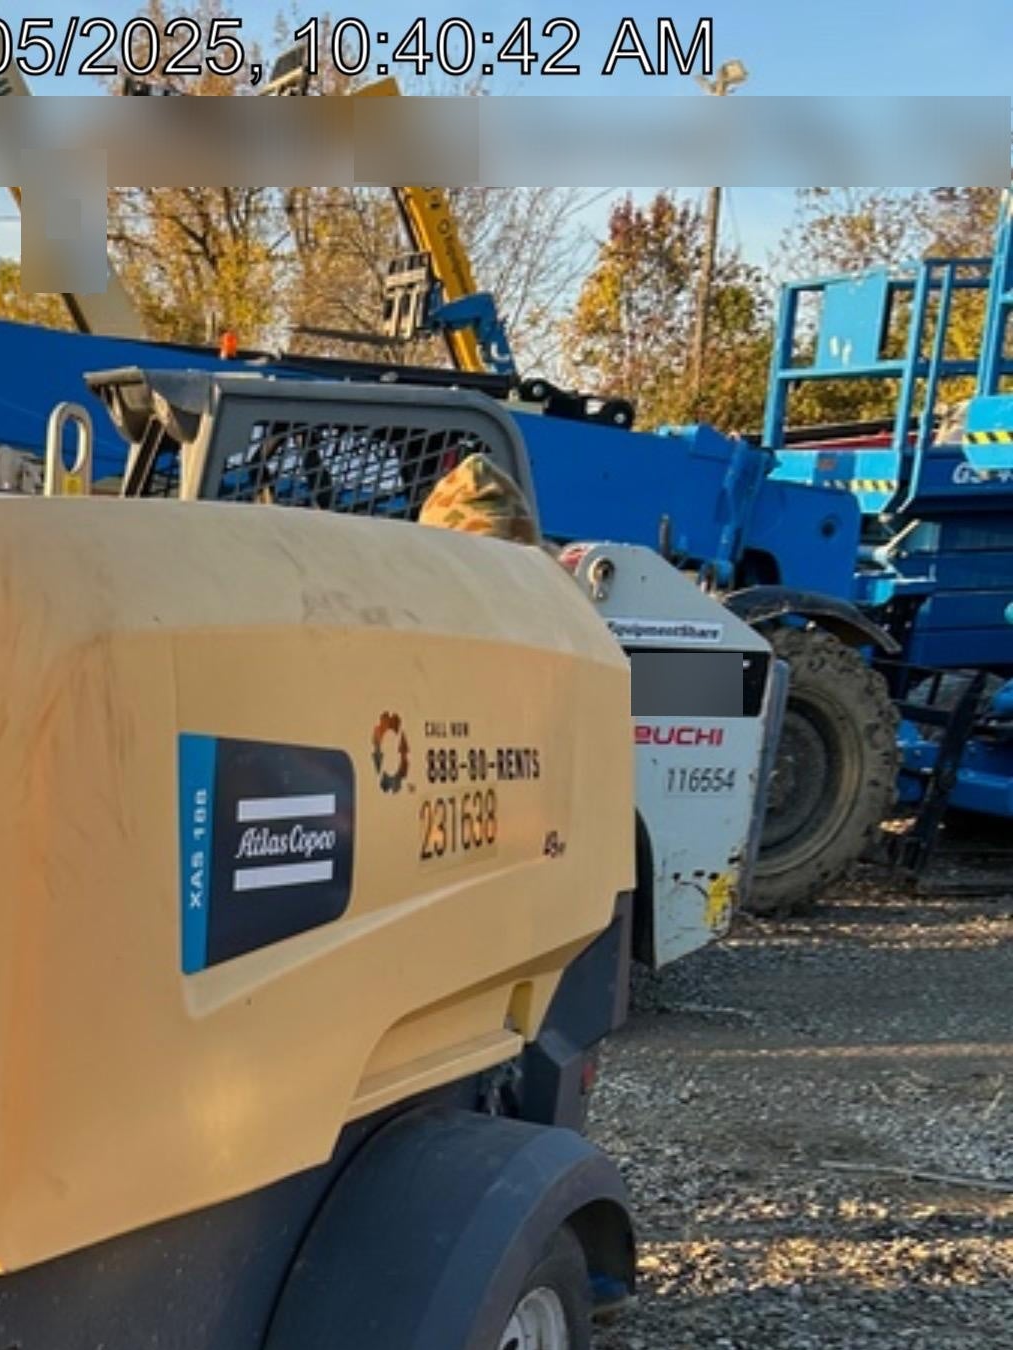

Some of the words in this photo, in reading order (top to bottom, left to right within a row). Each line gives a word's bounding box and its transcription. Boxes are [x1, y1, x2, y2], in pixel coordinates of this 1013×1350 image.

[667, 767, 736, 793] 116554
[234, 827, 288, 858] Atlas
[289, 824, 336, 857] Copco
[419, 788, 497, 860] 231638
